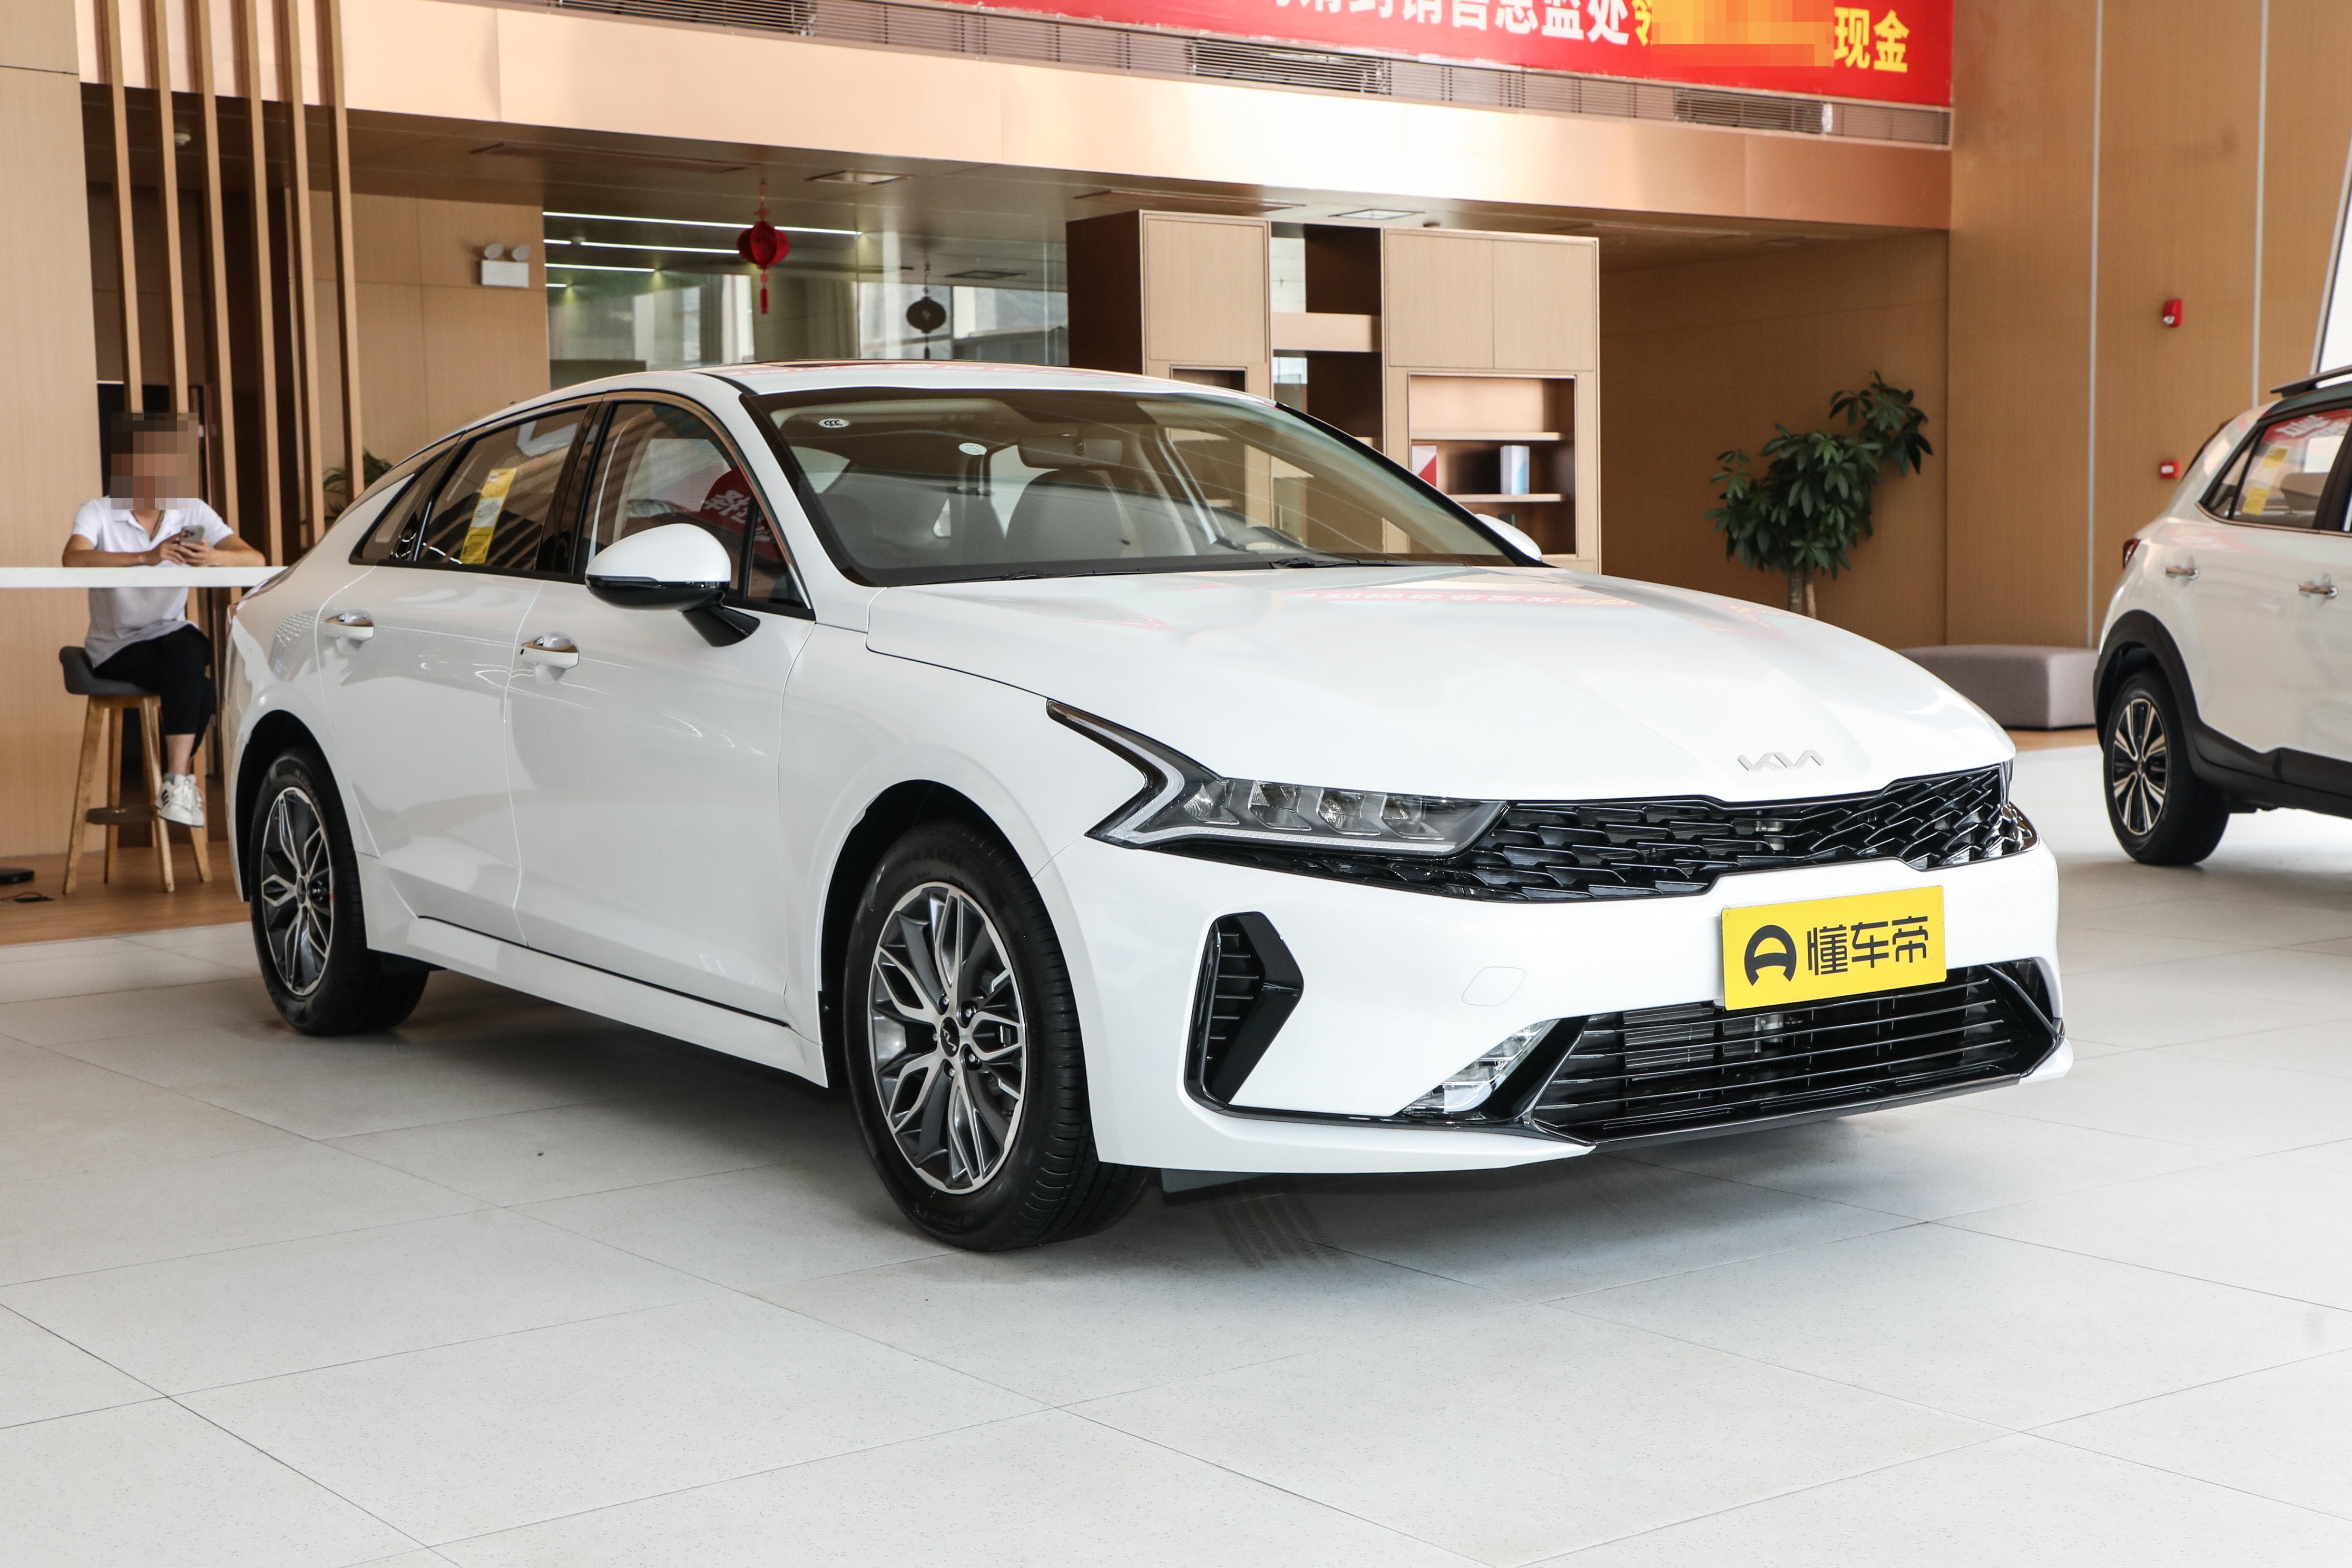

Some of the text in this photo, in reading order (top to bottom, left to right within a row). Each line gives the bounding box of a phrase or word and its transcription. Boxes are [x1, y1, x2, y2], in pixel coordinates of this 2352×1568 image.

[1834, 6, 1909, 73] 现金
[1806, 915, 1929, 976] 懂车帝
